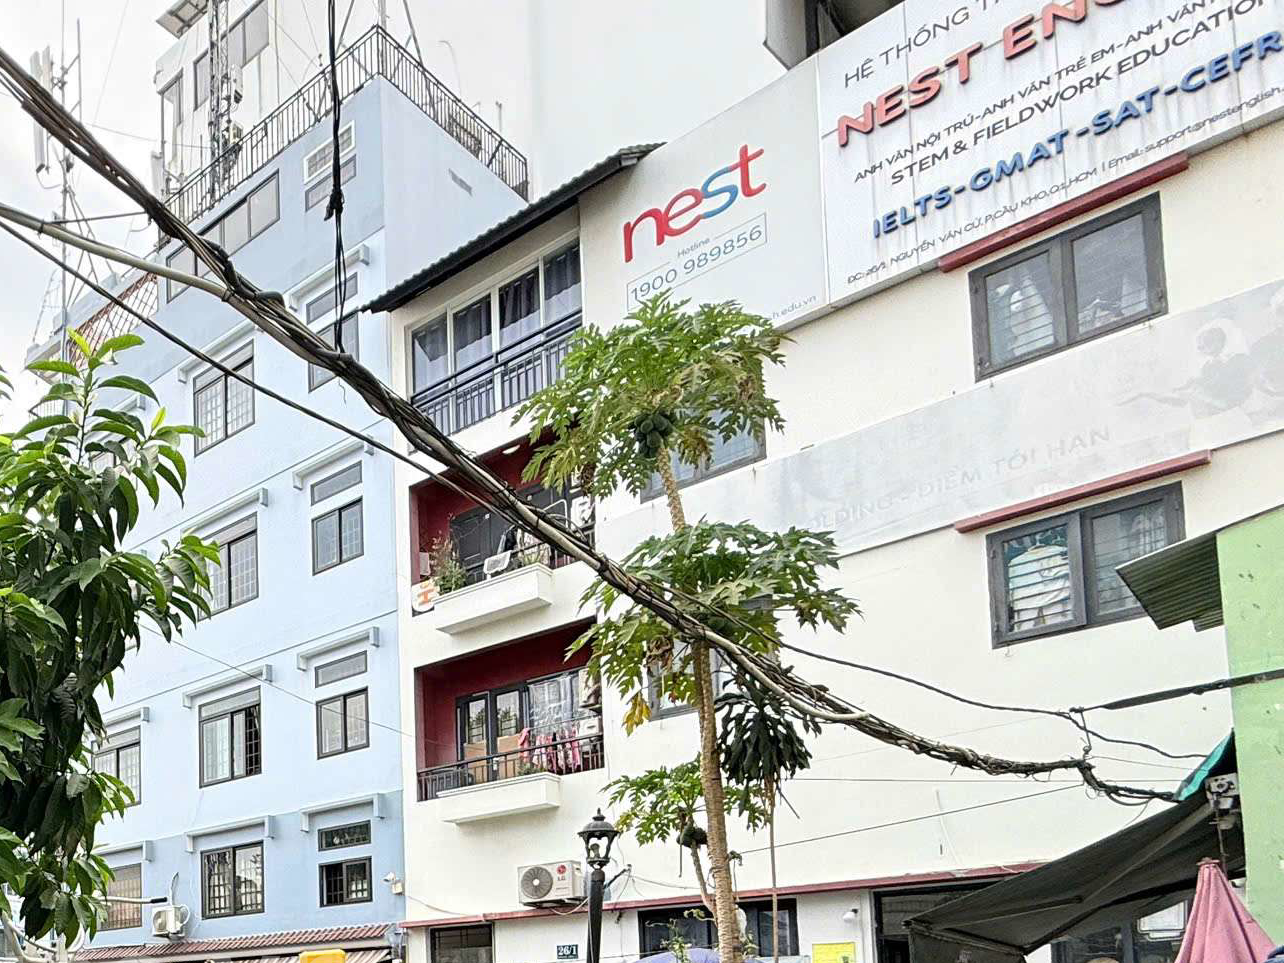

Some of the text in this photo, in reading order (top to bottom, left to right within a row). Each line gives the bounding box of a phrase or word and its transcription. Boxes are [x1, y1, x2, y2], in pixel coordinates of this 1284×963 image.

[838, 0, 1125, 148] NEST EN
[844, 7, 970, 88] HỆ THỐNG
[854, 162, 884, 183] ANH
[885, 145, 914, 166] VĂN
[1018, 76, 1052, 99] VĂN
[891, 149, 949, 185] STEM
[952, 140, 969, 155] &
[973, 66, 1112, 147] FIELDWORK
[623, 144, 767, 263] nest
[677, 237, 711, 258] Hotline
[630, 224, 762, 300] 1900 989856
[558, 945, 577, 956] 26/1
